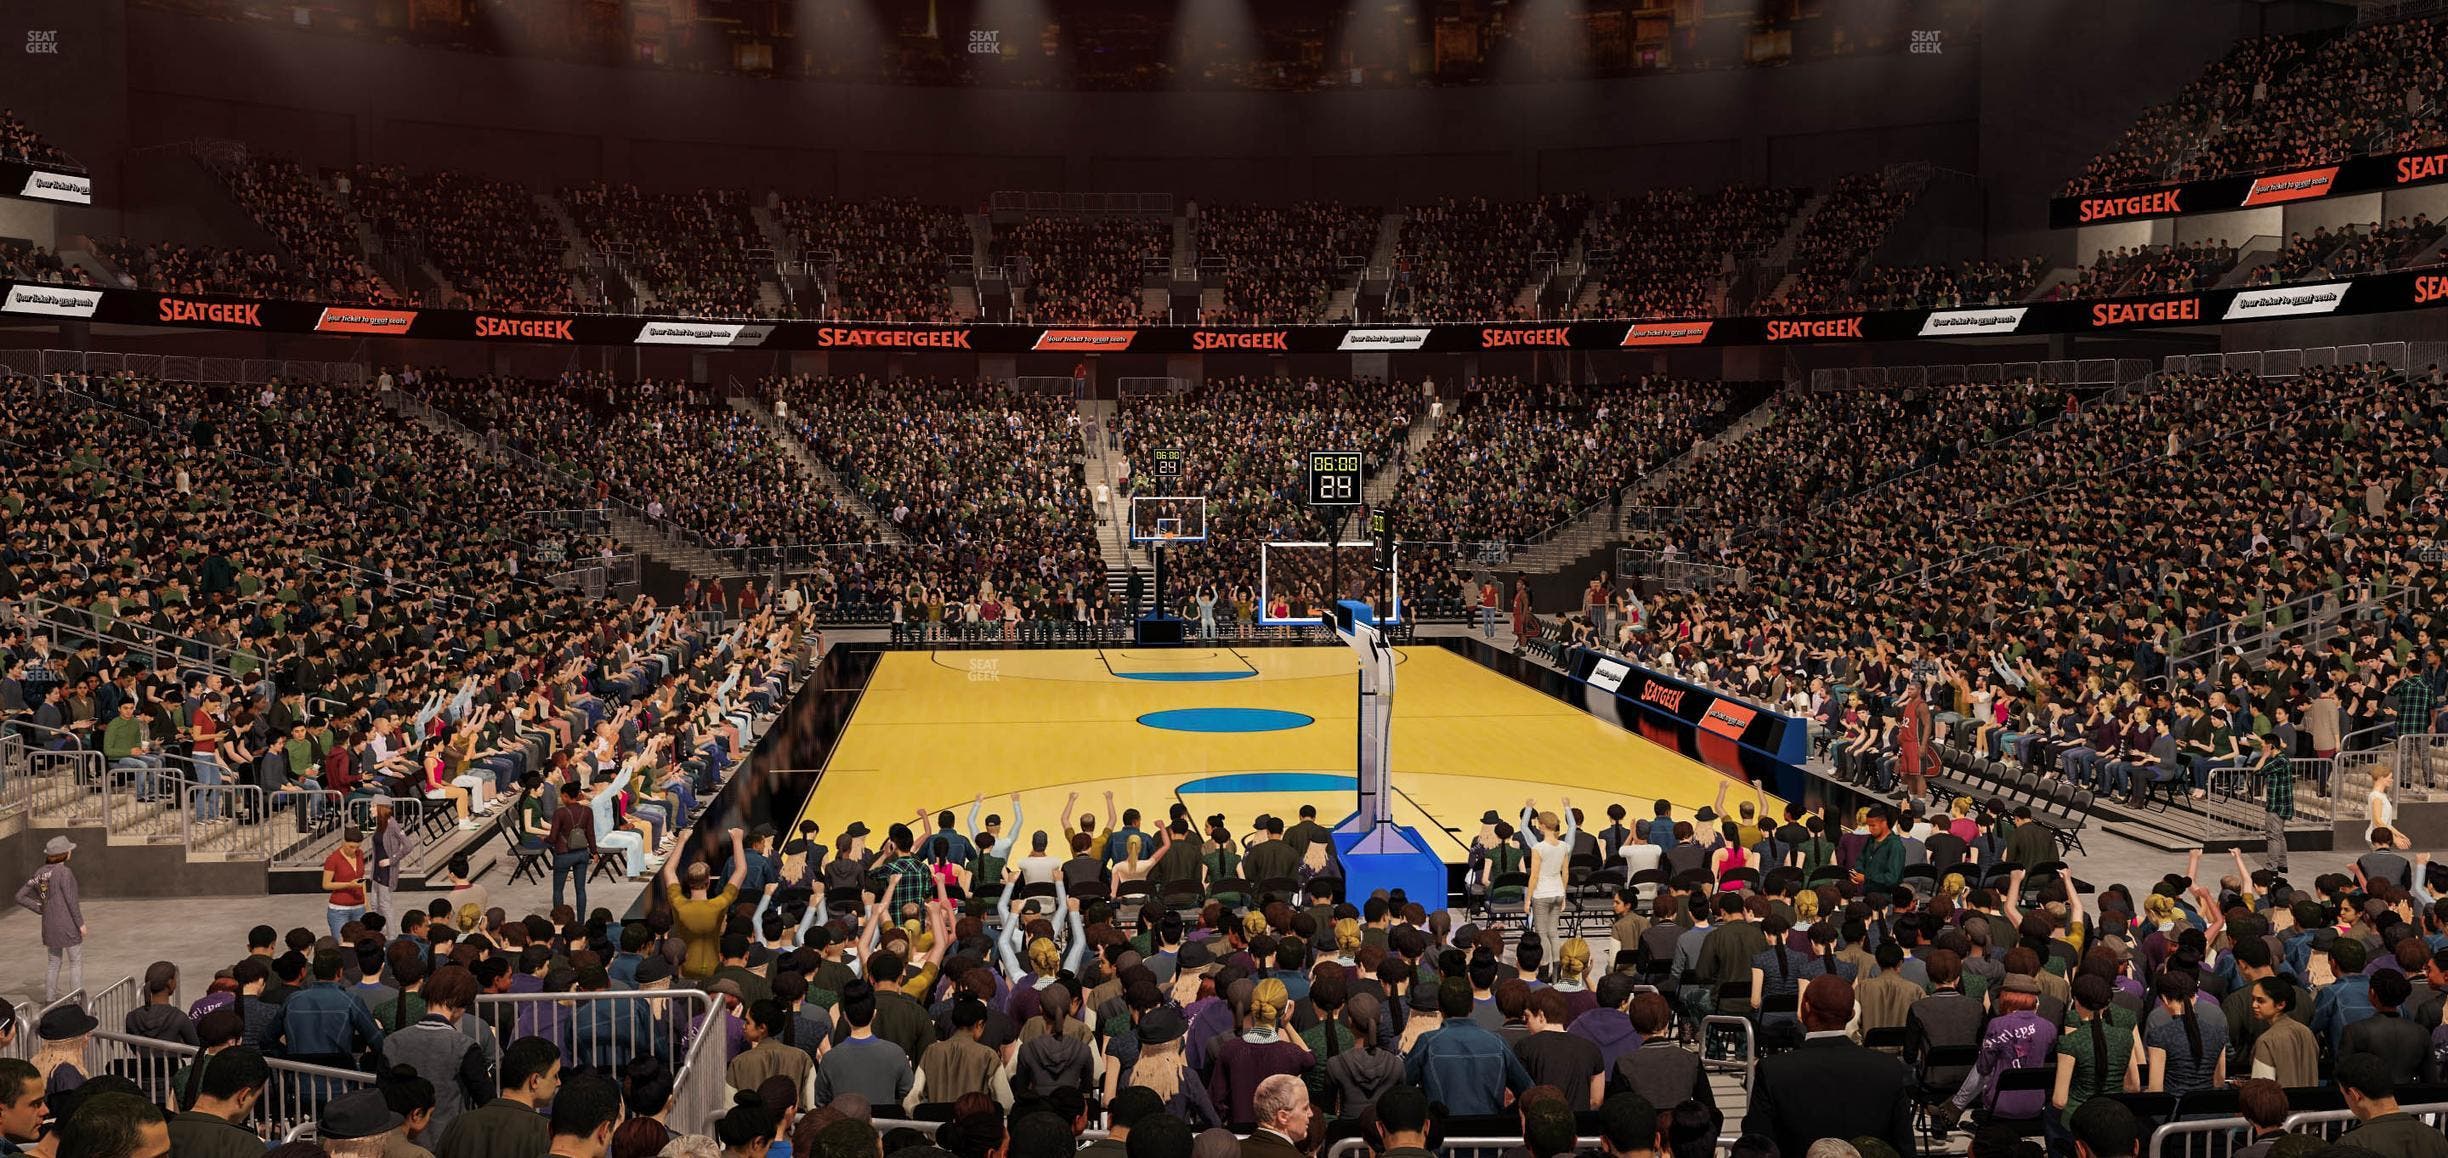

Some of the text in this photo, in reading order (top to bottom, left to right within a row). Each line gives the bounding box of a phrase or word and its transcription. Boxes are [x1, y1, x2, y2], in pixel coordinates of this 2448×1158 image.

[2288, 181, 2295, 189] to
[2079, 188, 2181, 222] SEATGEEK
[2282, 296, 2291, 305] to
[159, 297, 262, 327] SEATGEEK
[2092, 298, 2200, 327] SEATGEE
[475, 315, 574, 340] SEATGEEK
[1482, 327, 1571, 348] SEATGEEK
[1766, 316, 1863, 341] SEATGEEK
[1193, 331, 1288, 351] SEATGEEK
[1156, 451, 1180, 460] 06:00
[1314, 457, 1358, 471] 06:00
[1160, 461, 1177, 473] 24
[1321, 475, 1352, 498] 24
[1641, 679, 1685, 714] SEATGEEK
